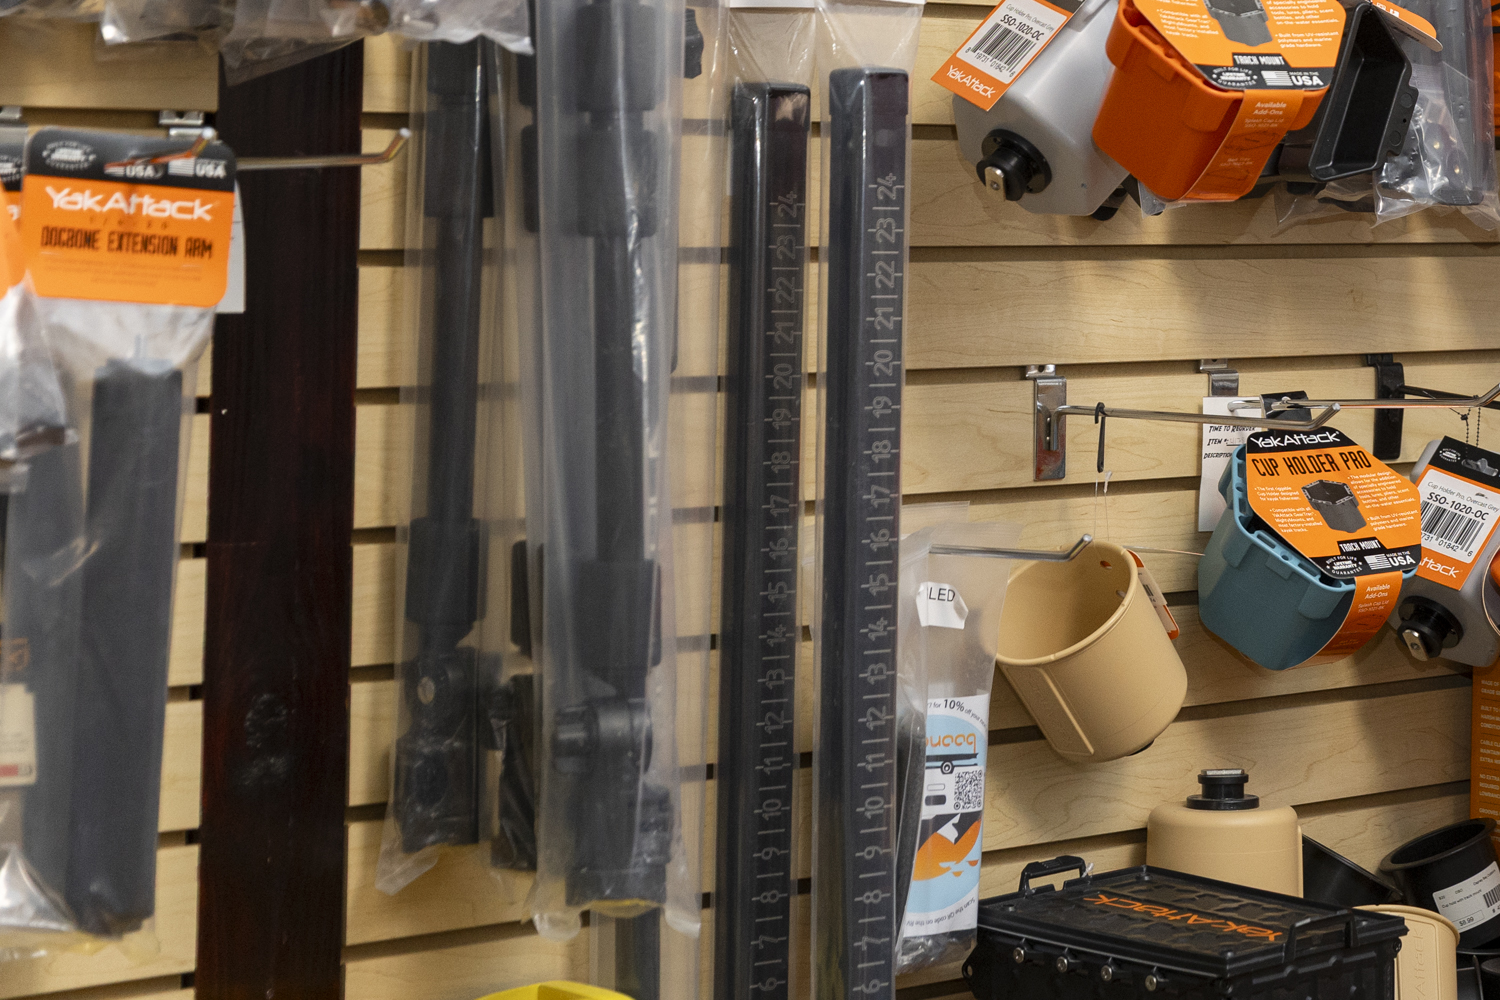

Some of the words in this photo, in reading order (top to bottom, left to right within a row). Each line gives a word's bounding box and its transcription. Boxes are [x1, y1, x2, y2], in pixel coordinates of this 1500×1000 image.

[1000, 13, 1045, 42] SSO-1020-OC
[1005, 3, 1014, 13] Cup
[1013, 7, 1026, 19] Holder
[1031, 16, 1046, 29] Overcast
[1233, 55, 1259, 65] TRACK
[1260, 55, 1285, 66] MOUNT
[946, 65, 997, 99] YakAttack
[1291, 75, 1324, 87] USA
[1253, 108, 1284, 117] Add-Ons
[1255, 101, 1287, 109] Available
[195, 164, 227, 179] USA
[876, 173, 897, 200] 24
[45, 186, 217, 221] YakAttack
[41, 225, 100, 252] DOGBONE
[107, 230, 178, 259] EXTENSION
[184, 239, 214, 260] ARM
[876, 217, 896, 244] 23
[875, 261, 896, 289] 22
[874, 306, 894, 330] 21
[874, 350, 894, 376] 20
[873, 396, 893, 419] 19
[1208, 425, 1223, 433] TIME
[1250, 431, 1341, 449] YakAttack
[872, 439, 892, 463] 18
[1207, 438, 1223, 446] ITEM
[1251, 458, 1280, 477] CUP
[1282, 453, 1341, 476] HOLDER
[1339, 450, 1372, 471] PRO
[871, 485, 891, 507] 17
[1426, 491, 1490, 522] SSO-1020-OC
[1427, 481, 1439, 491] Cup
[1438, 484, 1456, 497] Holder
[1466, 495, 1489, 509] Overcast
[1489, 504, 1500, 513] Grey
[870, 527, 890, 552] 16
[1339, 542, 1358, 553] TRACK
[1358, 540, 1381, 551] MOUNT
[1438, 539, 1460, 553] 01842
[1388, 556, 1416, 567] USA
[869, 573, 889, 597] 15
[928, 586, 956, 602] LED
[868, 617, 888, 641] 14
[943, 698, 965, 713] 10%
[1084, 893, 1281, 942] YakAttack
[1458, 916, 1475, 927] $8.99
